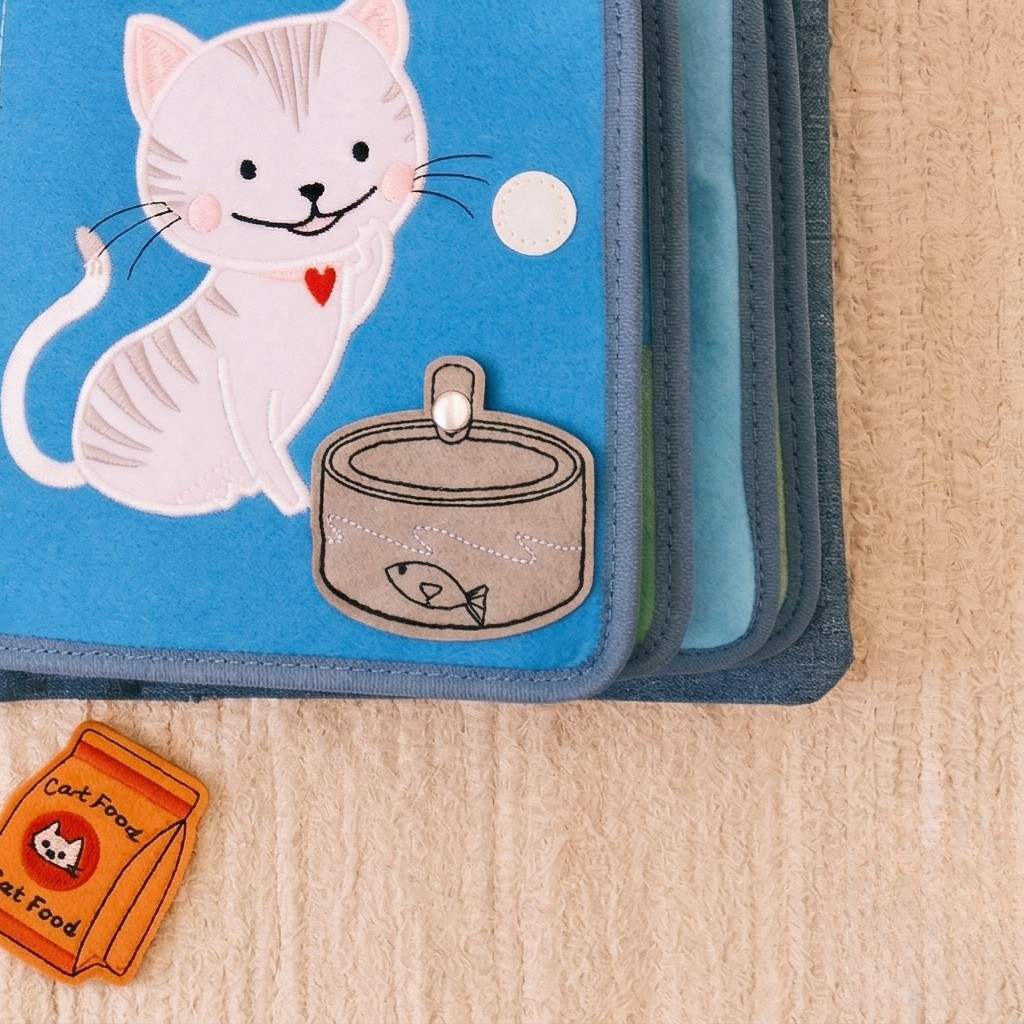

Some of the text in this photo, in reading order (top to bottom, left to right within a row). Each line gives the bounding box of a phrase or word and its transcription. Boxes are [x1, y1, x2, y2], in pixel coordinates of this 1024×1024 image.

[43, 777, 144, 844] Cat Food
[26, 895, 82, 938] Food
